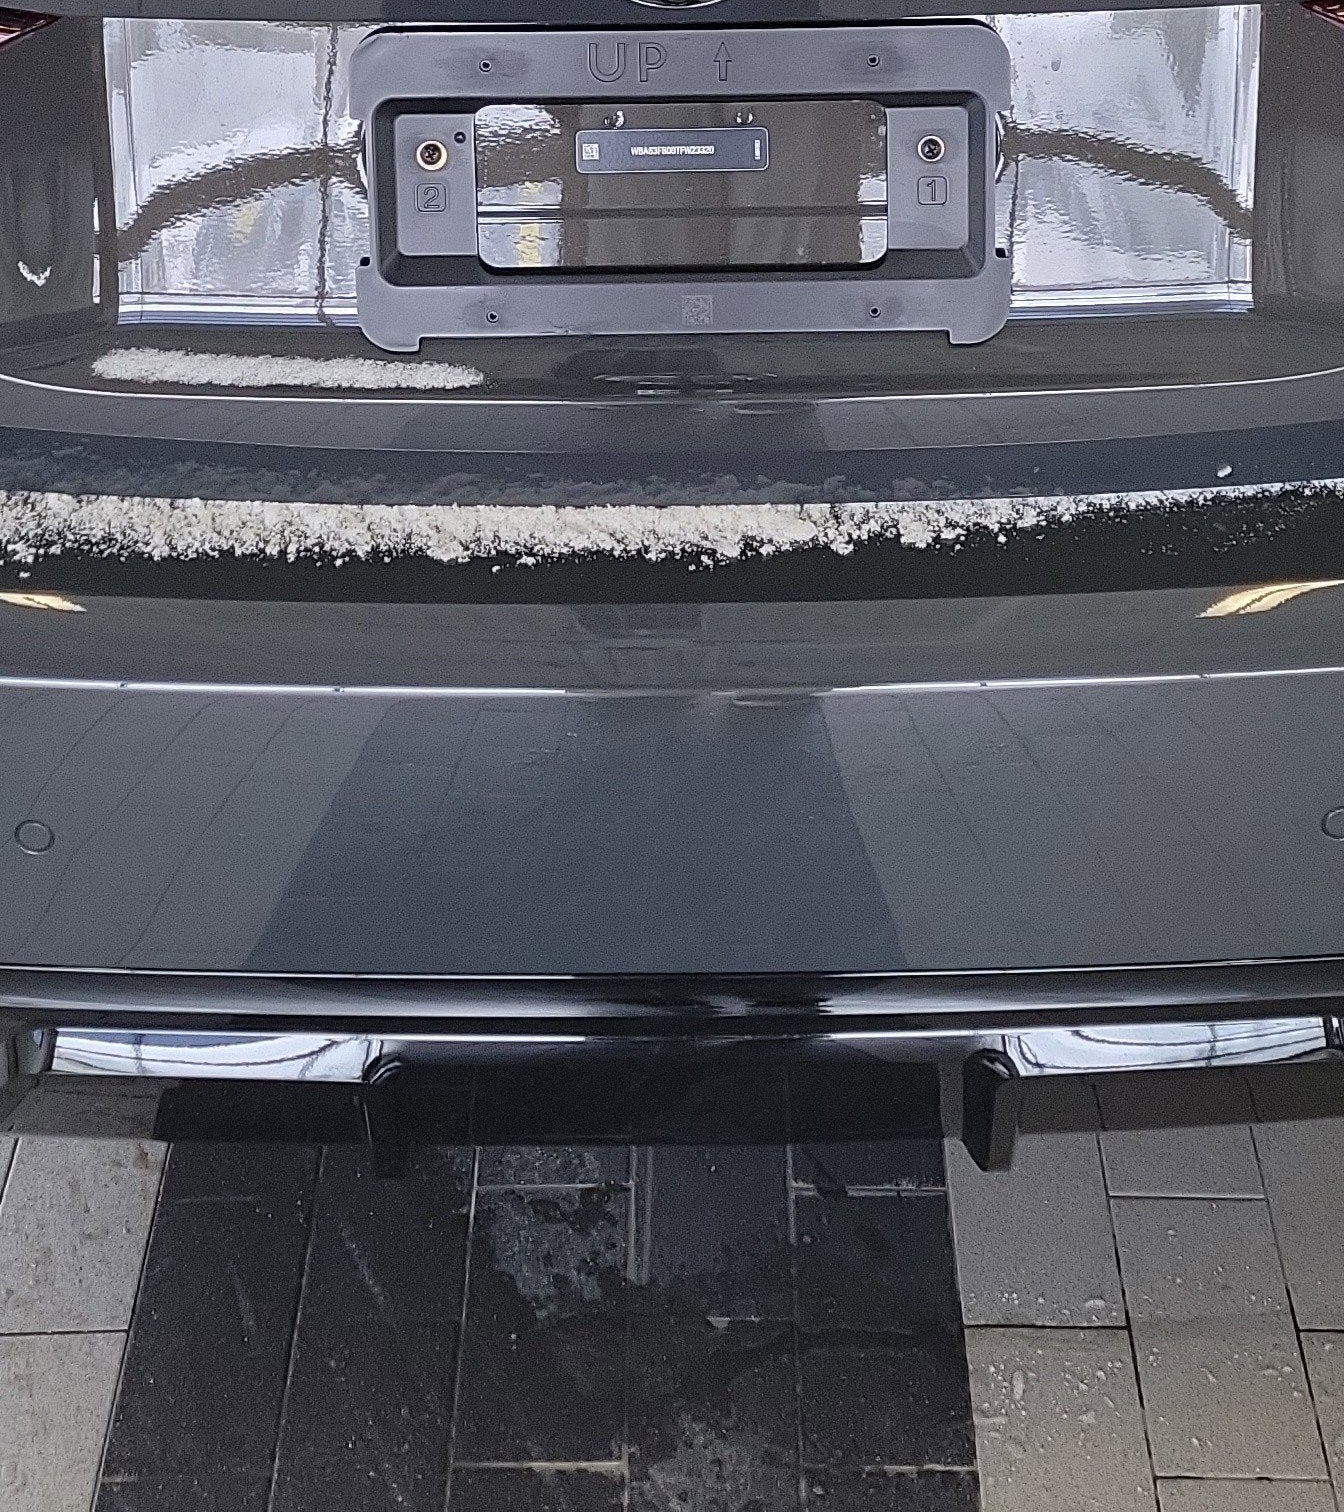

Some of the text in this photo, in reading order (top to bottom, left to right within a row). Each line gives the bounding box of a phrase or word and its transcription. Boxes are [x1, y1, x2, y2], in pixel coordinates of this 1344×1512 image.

[587, 41, 668, 83] UP
[423, 186, 440, 209] 2
[926, 179, 936, 201] 1
